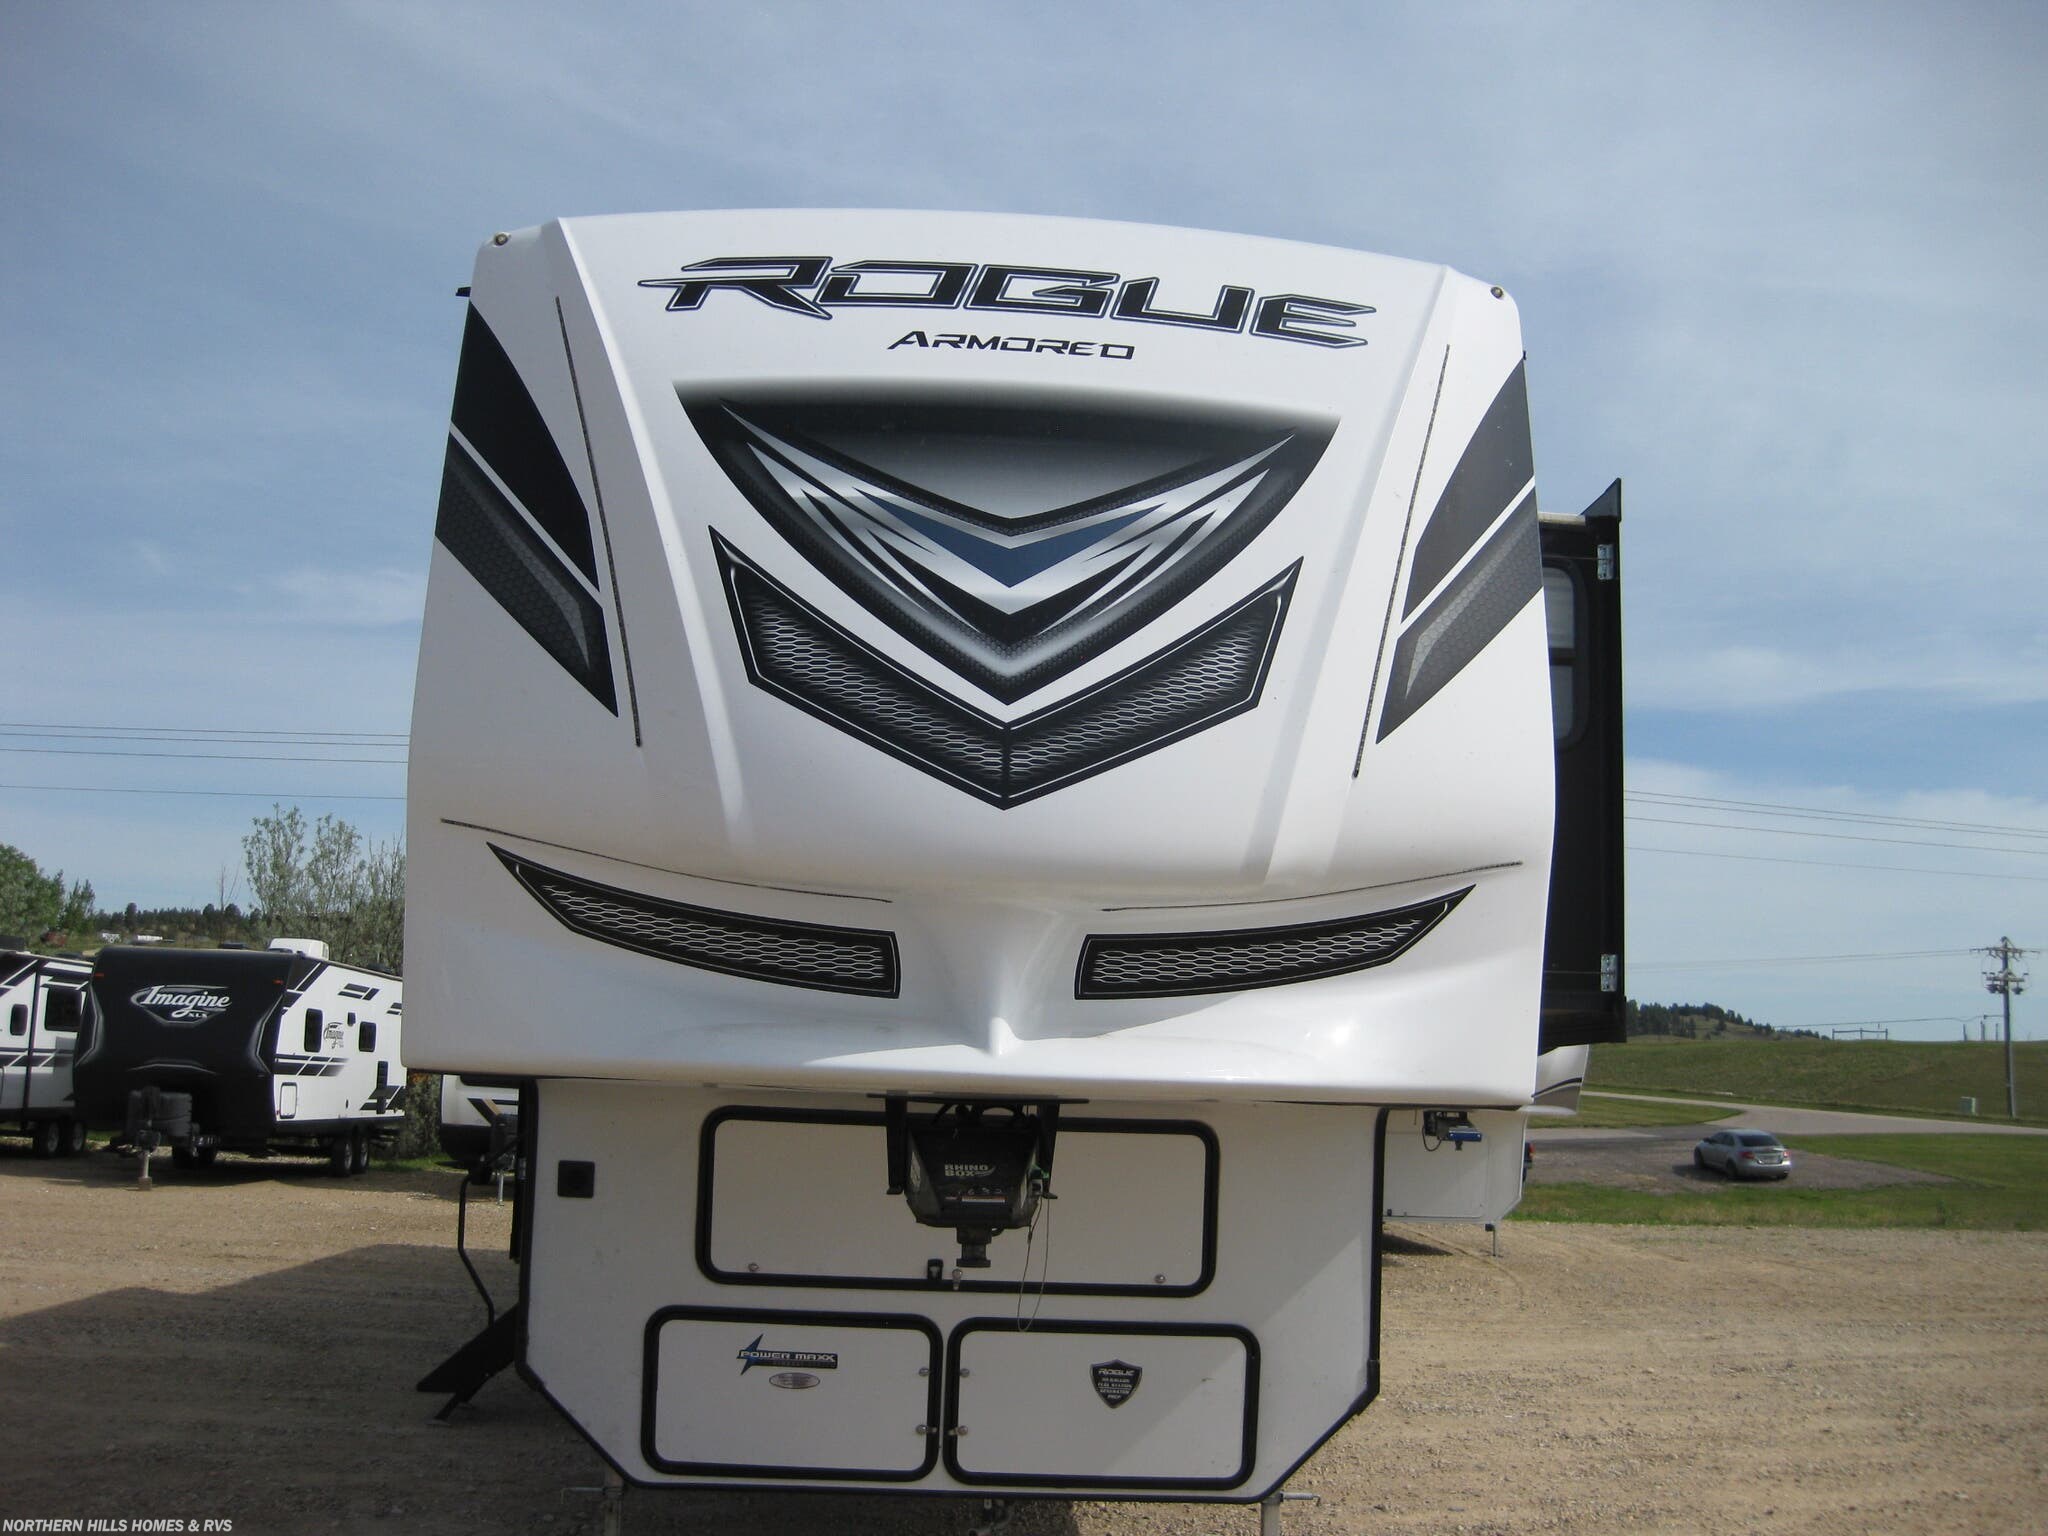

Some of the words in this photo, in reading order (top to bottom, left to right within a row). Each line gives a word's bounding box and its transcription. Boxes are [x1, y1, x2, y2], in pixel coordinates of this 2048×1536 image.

[637, 256, 1378, 348] ROGUE
[887, 330, 1135, 360] ARMORED
[140, 985, 232, 1018] Imagine
[740, 1351, 791, 1360] POWER
[795, 1353, 836, 1363] MAXX
[1098, 1368, 1135, 1377] ROGUE
